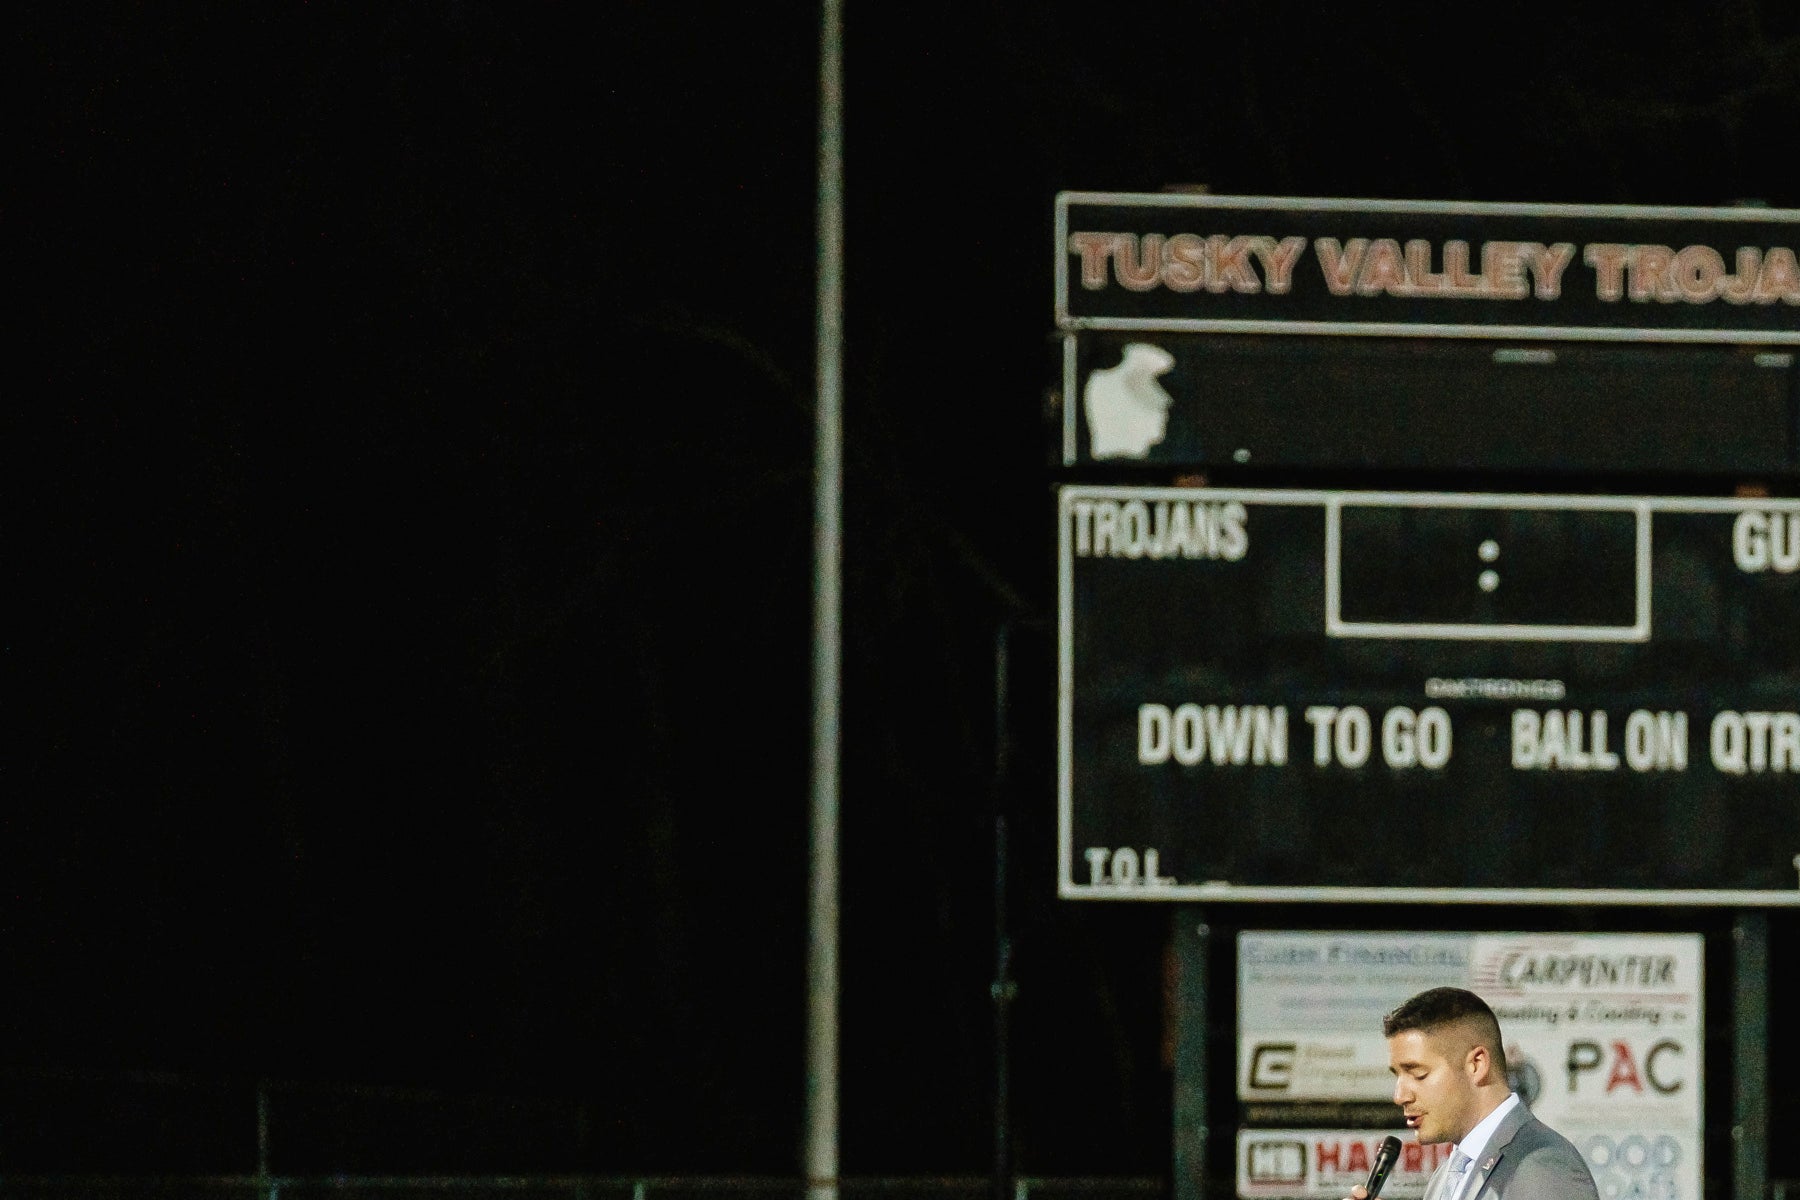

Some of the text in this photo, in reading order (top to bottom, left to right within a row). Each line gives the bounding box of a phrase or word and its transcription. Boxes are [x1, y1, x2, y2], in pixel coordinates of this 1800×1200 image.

[1070, 231, 1306, 295] TUSKY
[1314, 238, 1575, 301] VALLEY
[1072, 500, 1248, 561] TROJANS
[1138, 703, 1451, 769] DOWN TO GO
[1511, 709, 1619, 771] BALL
[1625, 710, 1687, 772] ON
[1500, 952, 1678, 989] CARPENTER
[1566, 1037, 1684, 1096] PAC
